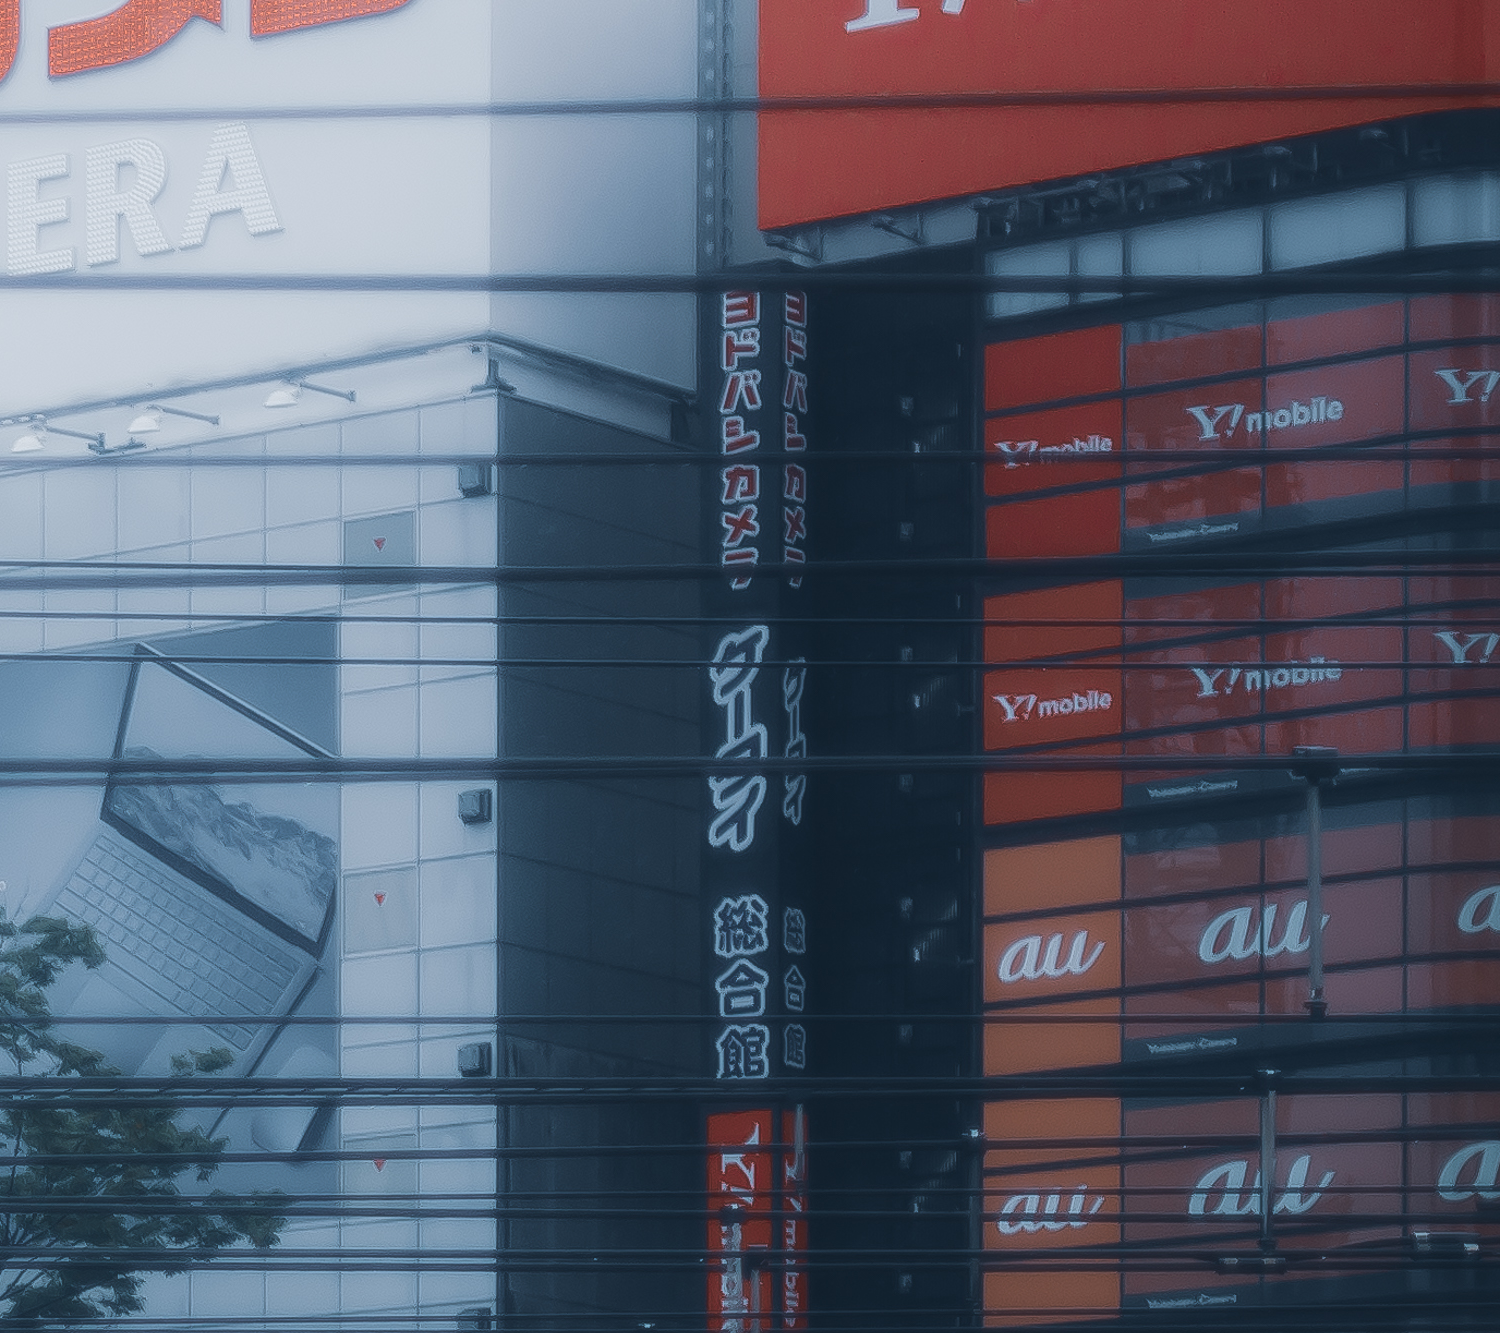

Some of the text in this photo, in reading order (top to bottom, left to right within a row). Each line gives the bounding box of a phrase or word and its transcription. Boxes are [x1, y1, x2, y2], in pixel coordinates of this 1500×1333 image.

[1186, 393, 1345, 442] Y!mobile
[993, 688, 1113, 725] Y!mobile
[998, 929, 1106, 984] au
[1198, 899, 1330, 967] au
[714, 894, 770, 1079] 総合館
[997, 1183, 1106, 1237] au
[1187, 1155, 1337, 1219] au
